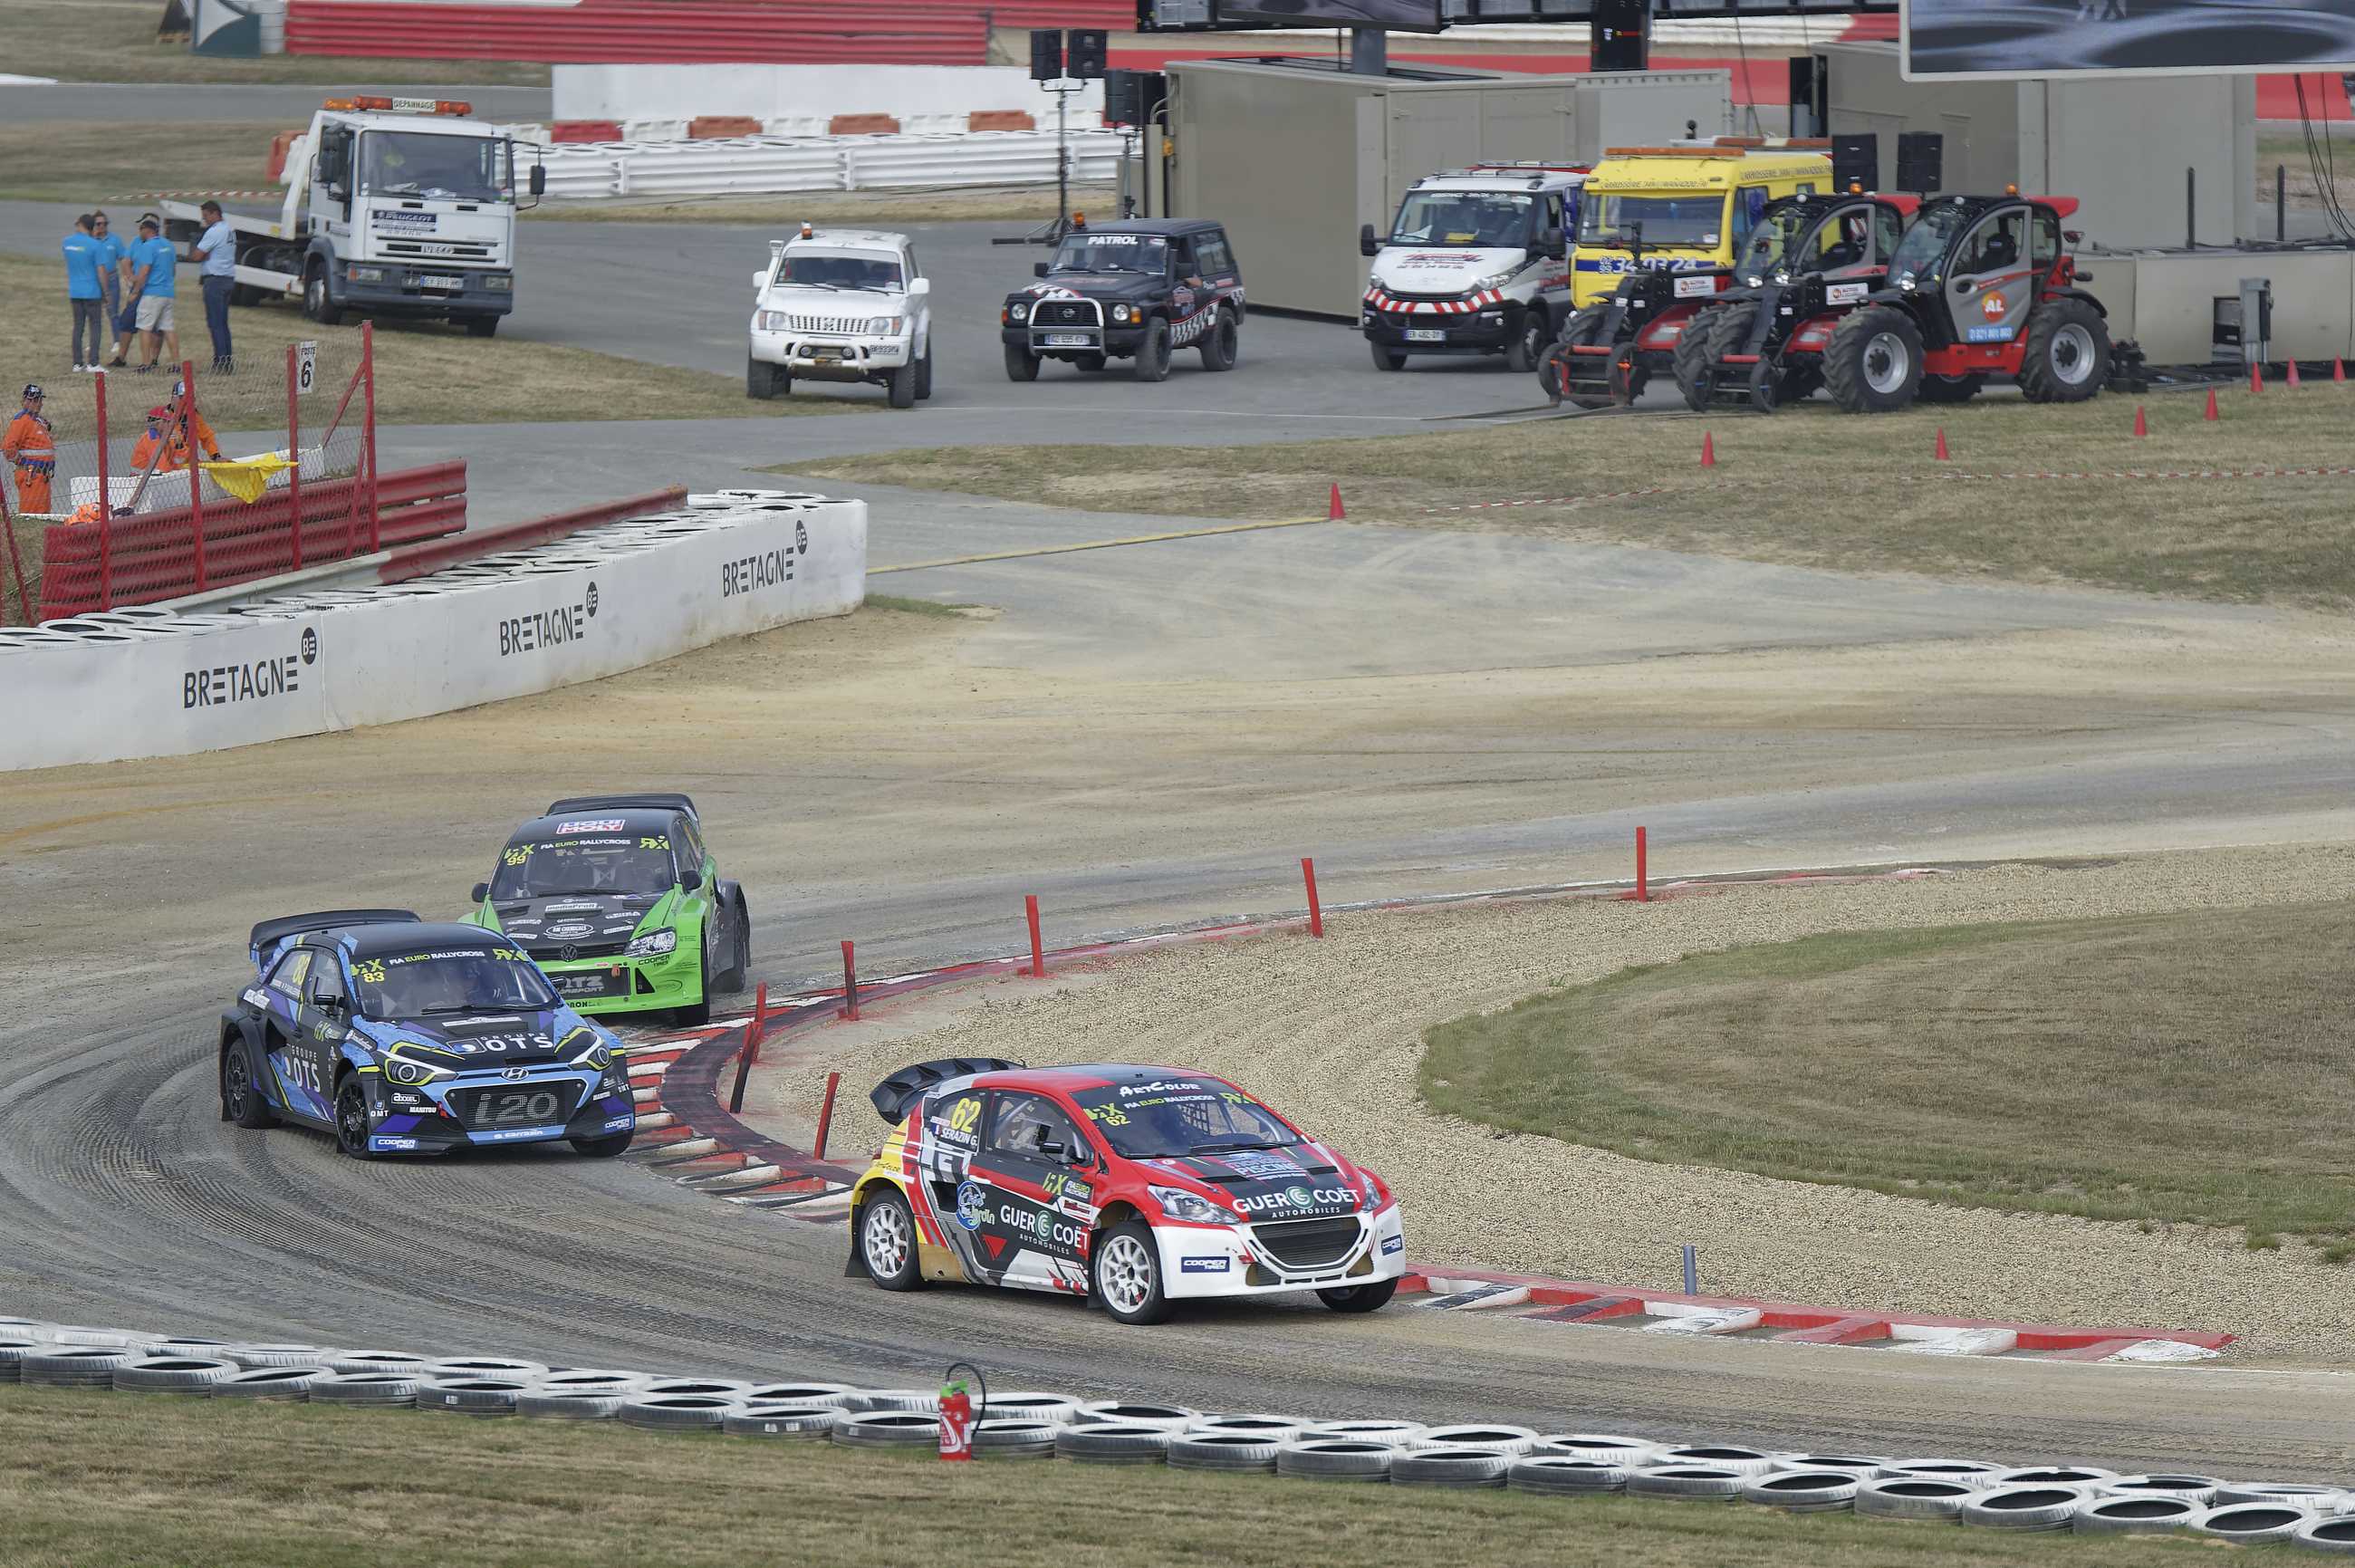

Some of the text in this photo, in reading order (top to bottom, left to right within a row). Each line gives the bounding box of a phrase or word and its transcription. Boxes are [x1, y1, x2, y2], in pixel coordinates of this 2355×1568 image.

[1087, 236, 1138, 245] PATROL
[1671, 256, 1697, 273] 24
[1985, 299, 2004, 313] AL
[301, 361, 312, 388] 6
[723, 546, 793, 598] BRETAGNE
[500, 604, 583, 656] BRETAGNE
[184, 656, 298, 708] BRETAGNE
[555, 840, 579, 848] EURO
[506, 855, 526, 866] 99
[405, 954, 430, 963] EURO
[430, 951, 485, 959] RALLYCROSS
[638, 954, 670, 966] COOPER
[293, 954, 311, 985] 83
[364, 972, 385, 983] 83
[481, 1032, 545, 1041] GROUPE
[484, 1036, 553, 1052] OTS
[292, 1045, 317, 1063] GROUPE
[293, 1057, 321, 1092] OTS
[475, 1092, 558, 1124] i20
[1124, 1094, 1216, 1110] FIA EURO RALLYCROSS
[605, 1118, 630, 1129] COOPER
[951, 1097, 982, 1134] 62
[1105, 1115, 1130, 1127] 62
[940, 1127, 970, 1144] SERAZIN
[1272, 1207, 1341, 1218] AUTOMOBILES
[1019, 1234, 1070, 1255] AUTOMOBILES
[1183, 1259, 1227, 1267] COOPER
